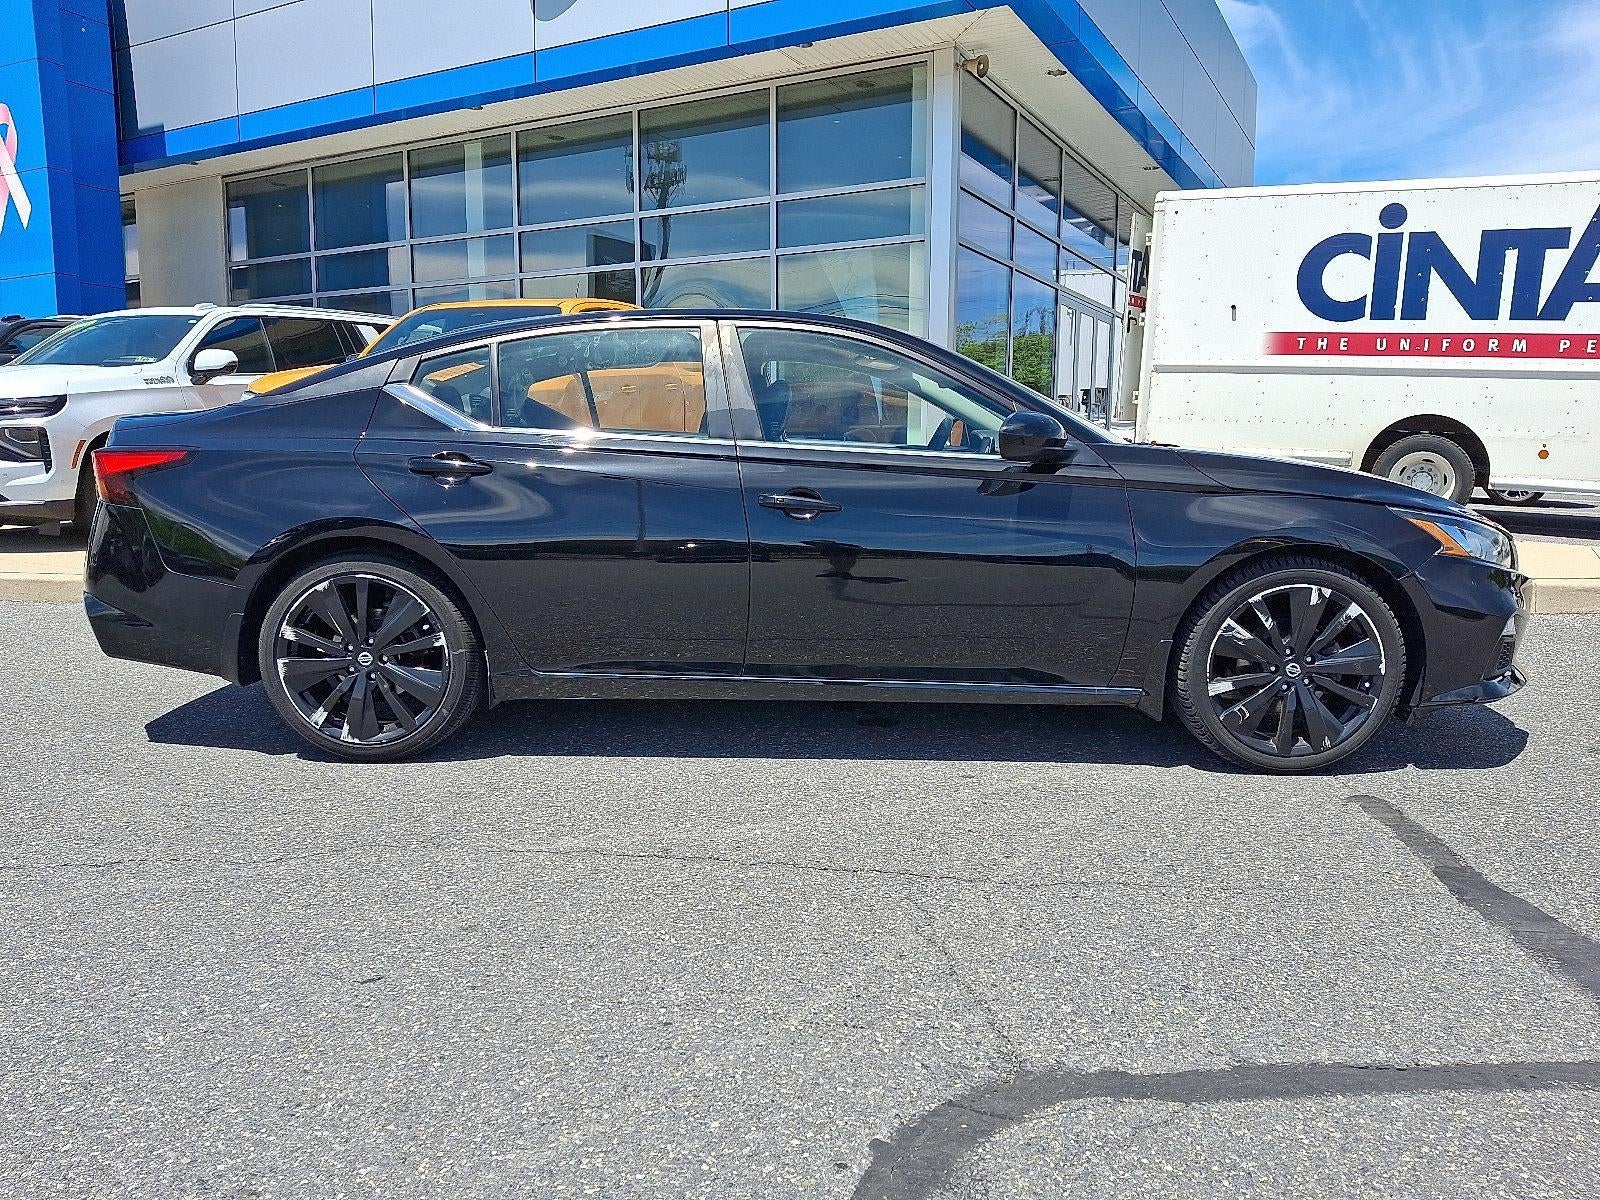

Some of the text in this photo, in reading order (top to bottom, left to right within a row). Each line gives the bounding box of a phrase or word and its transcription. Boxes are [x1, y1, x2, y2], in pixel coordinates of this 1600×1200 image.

[1296, 337, 1598, 354] THE UNIFORM PE
